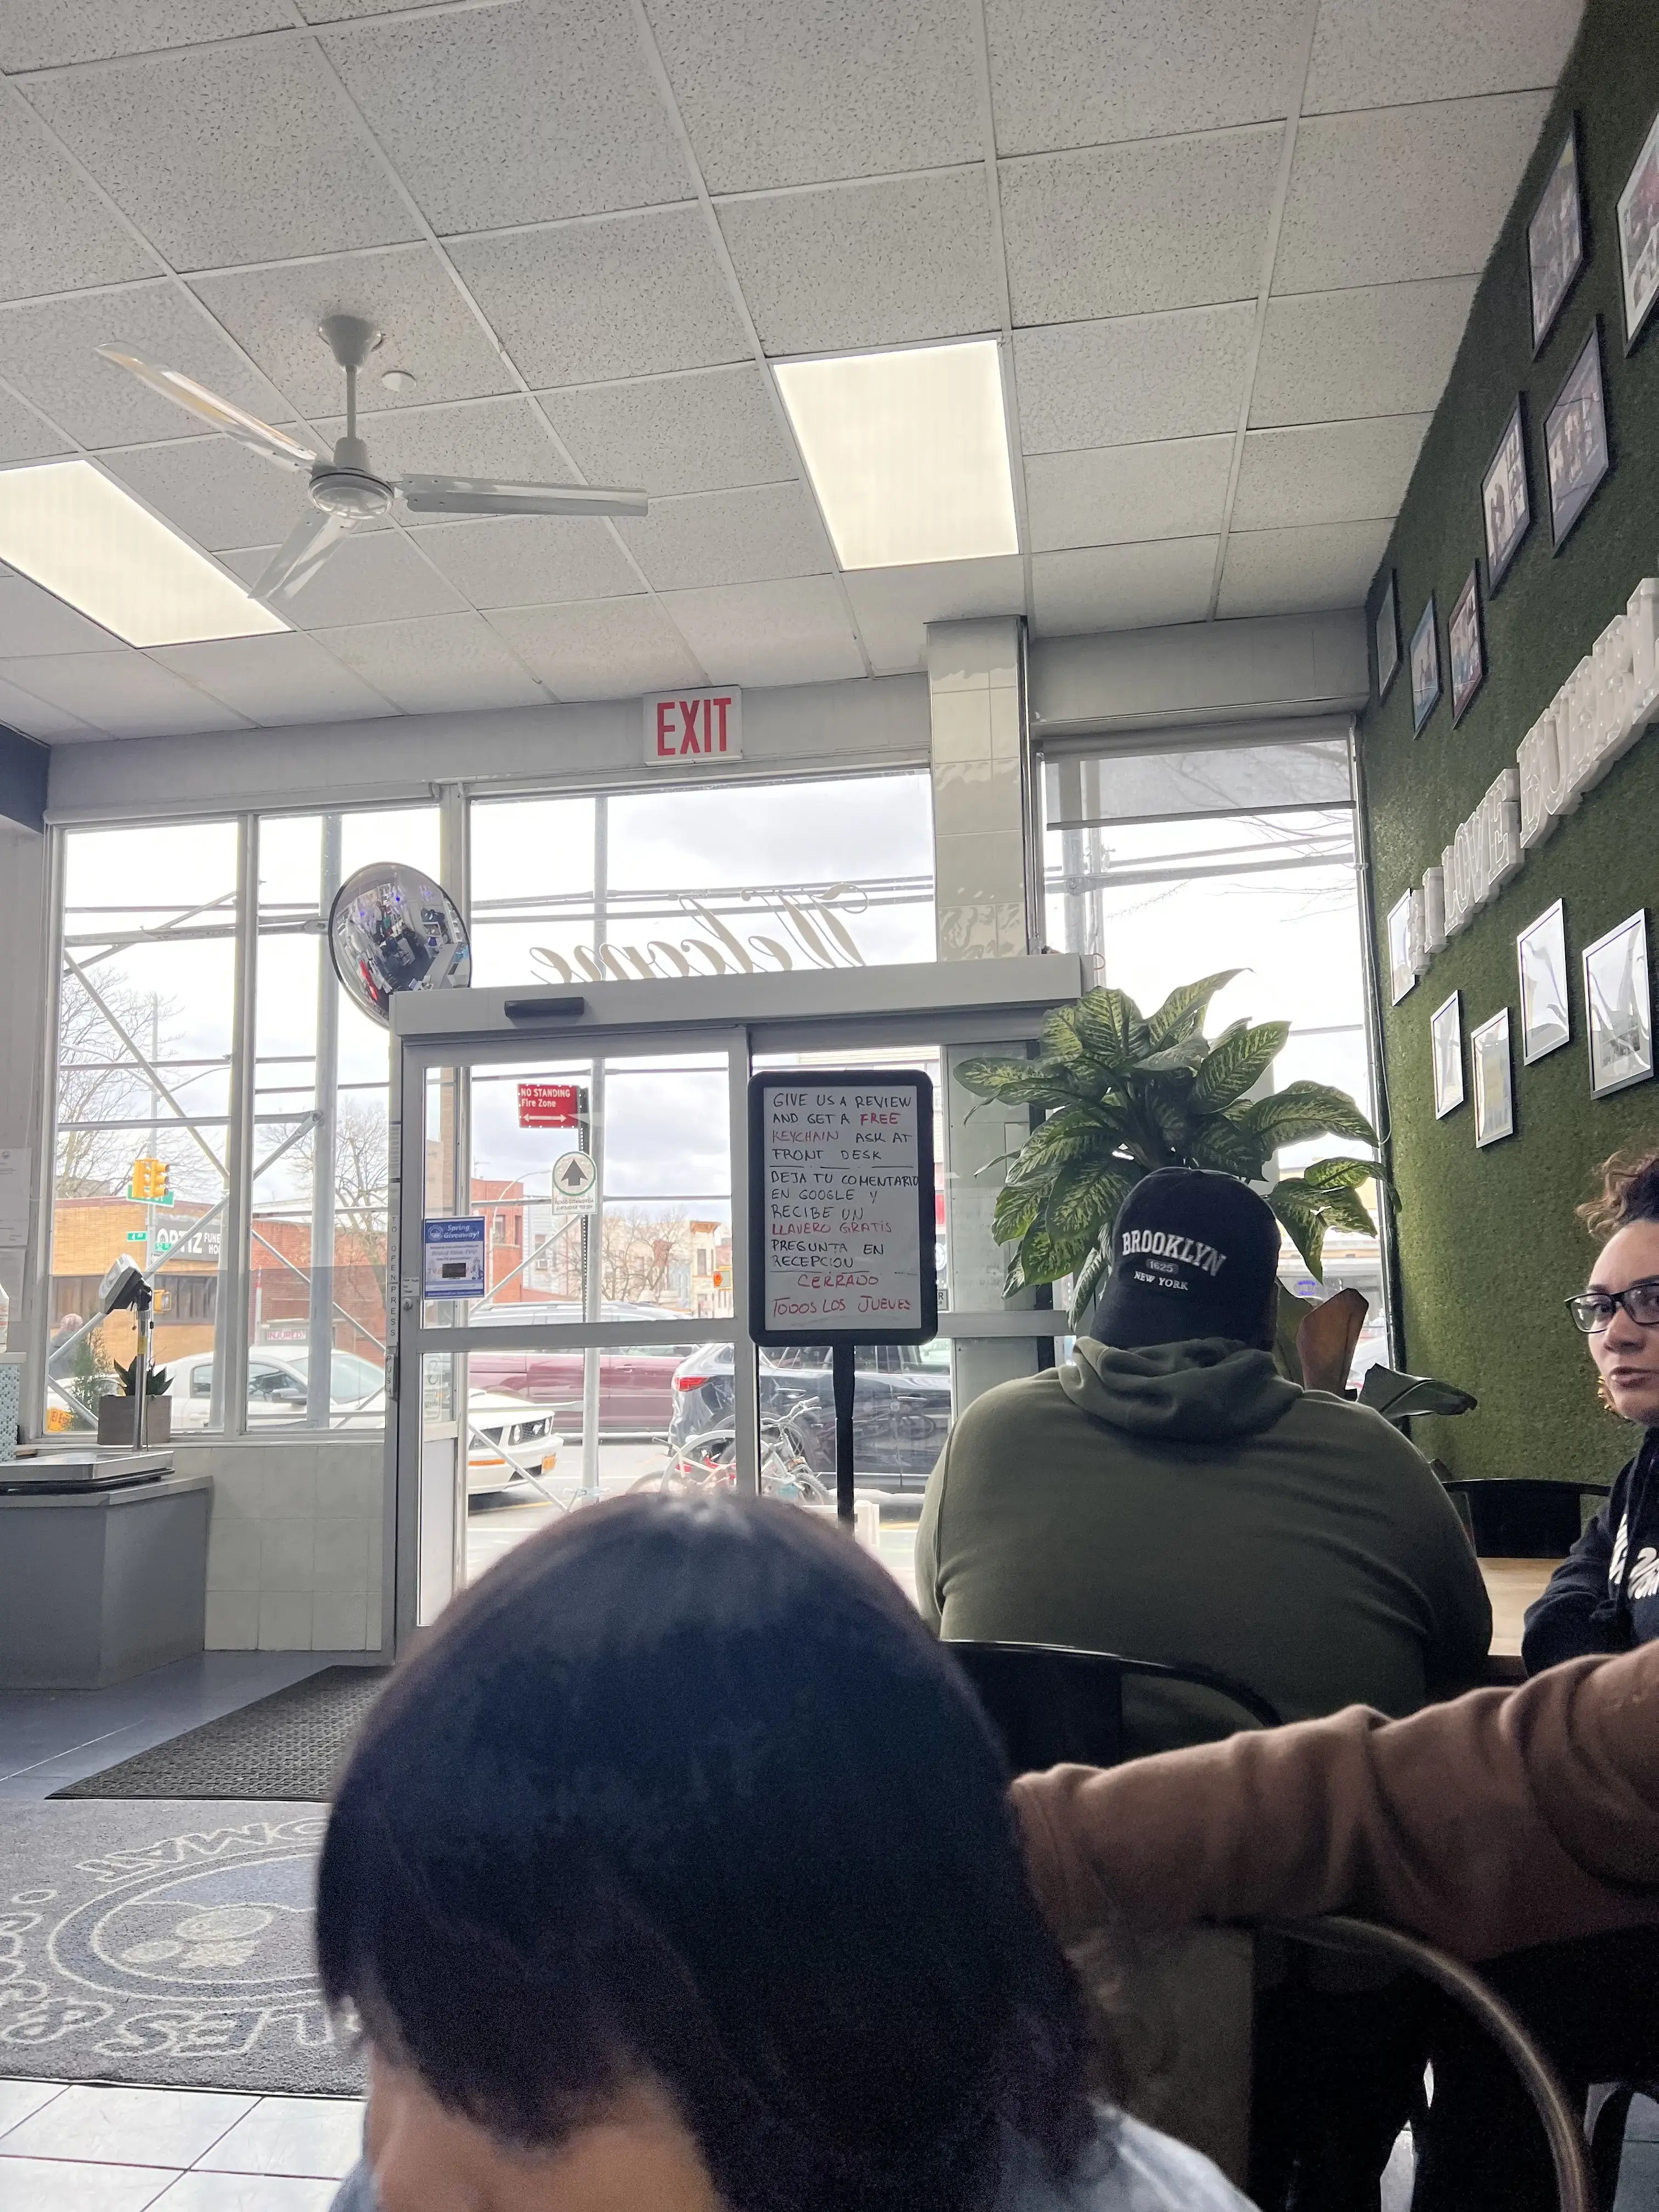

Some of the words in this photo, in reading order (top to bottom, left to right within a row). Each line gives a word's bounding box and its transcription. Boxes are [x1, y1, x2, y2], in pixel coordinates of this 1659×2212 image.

[657, 697, 731, 756] EXIT
[1442, 768, 1514, 937] LOVE
[1517, 578, 1659, 849] BUBBL
[521, 1088, 532, 1097] NO
[533, 1088, 571, 1098] STANDING
[521, 1098, 536, 1107] Fire
[538, 1098, 556, 1107] Zone
[773, 1093, 808, 1108] GIVE
[817, 1094, 835, 1105] US
[840, 1096, 847, 1107] A
[856, 1096, 911, 1108] REVIEW
[773, 1113, 798, 1124] AND
[807, 1114, 836, 1124] GET
[840, 1114, 850, 1124] A
[860, 1113, 901, 1125] FREE
[772, 1130, 839, 1143] KEYCHAIN
[856, 1133, 885, 1143] ASK
[893, 1132, 913, 1143] AT
[772, 1149, 825, 1161] FRONT
[840, 1150, 882, 1160] DESK
[771, 1172, 806, 1184] DEJA
[813, 1173, 833, 1183] TU
[841, 1175, 919, 1186] COMENTARIO
[772, 1189, 789, 1199] EN
[799, 1189, 854, 1200] GOOGLE
[771, 1205, 834, 1220] RECIBE
[842, 1207, 863, 1221] UN
[443, 1231, 480, 1239] Giveaway!
[772, 1223, 831, 1235] LLAVERO
[204, 1232, 221, 1243] FUNE
[209, 1244, 219, 1255] HO
[771, 1239, 848, 1252] PREGUNTA
[864, 1245, 884, 1255] EN
[1122, 1229, 1227, 1277] BROOKLYN
[1149, 1261, 1174, 1273] 1625
[1133, 1271, 1155, 1283] NEW
[1158, 1277, 1189, 1290] YORK
[772, 1297, 816, 1317] TODOS
[822, 1299, 845, 1312] LOS
[857, 1295, 911, 1313] JUEVES
